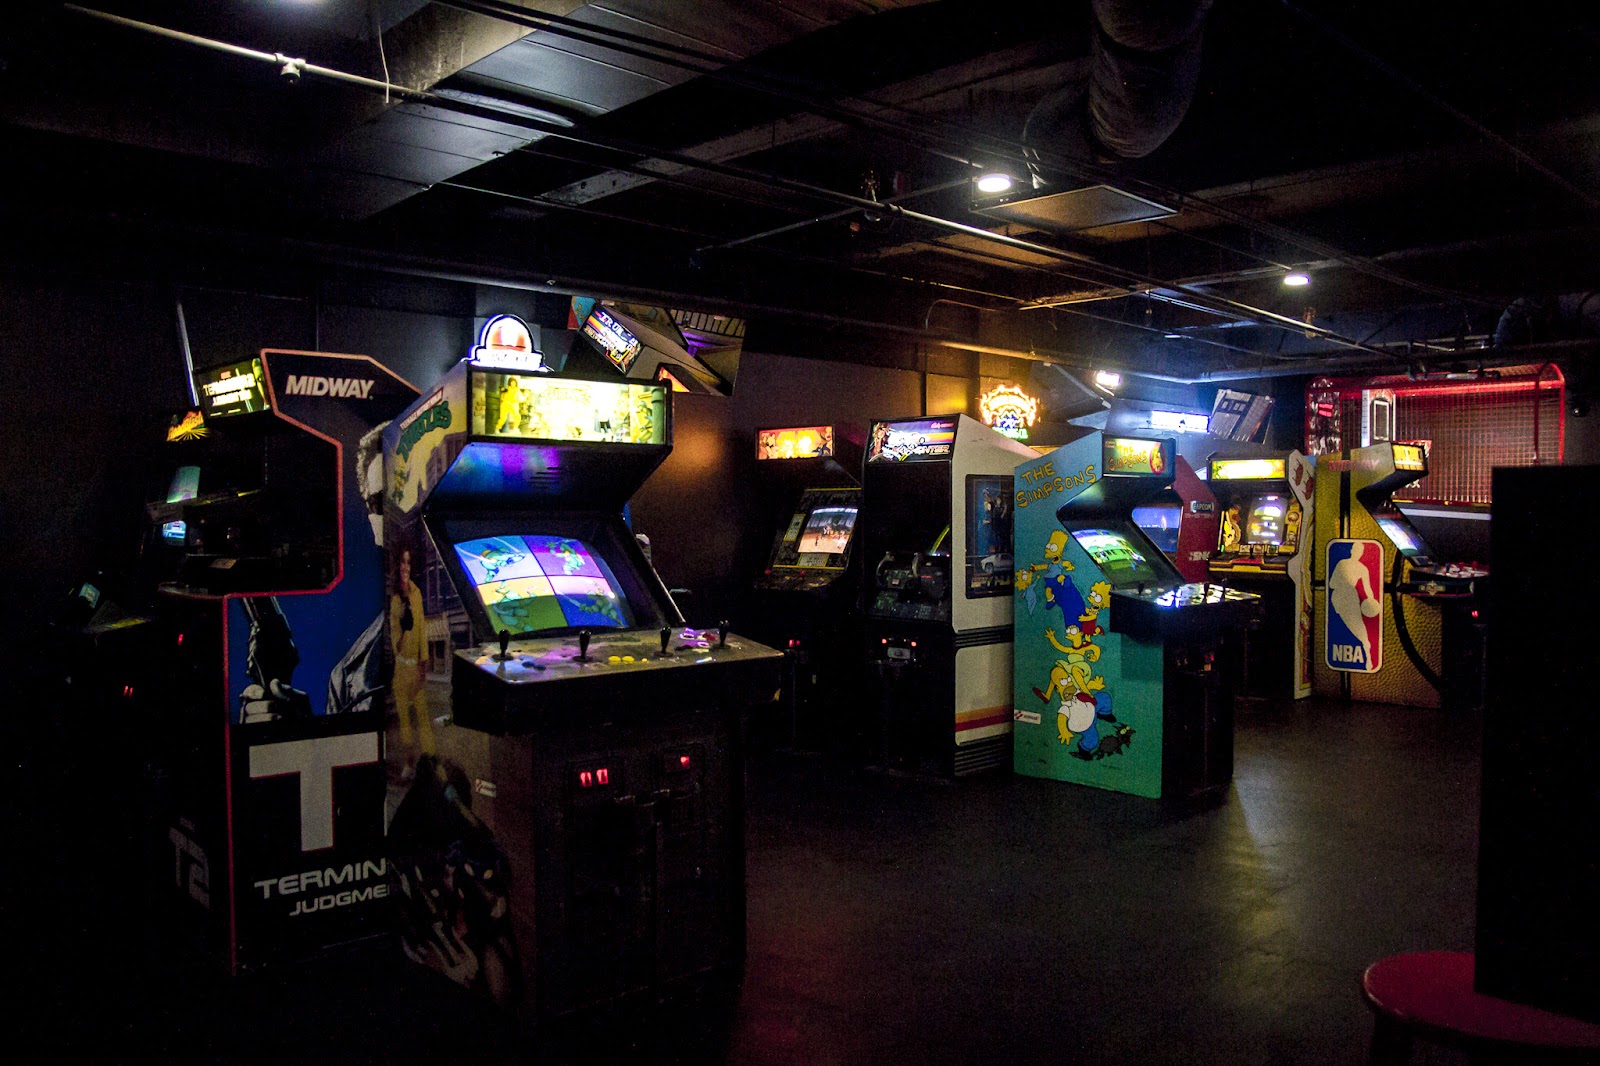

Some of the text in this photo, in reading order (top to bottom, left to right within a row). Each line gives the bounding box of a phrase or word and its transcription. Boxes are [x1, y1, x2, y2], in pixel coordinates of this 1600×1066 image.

[285, 374, 375, 400] MIDWAY
[396, 400, 452, 463] TURTLES
[1108, 450, 1148, 471] SIMPSONS
[1021, 462, 1056, 484] THE
[1015, 465, 1097, 508] SIMPSONS
[1191, 501, 1214, 512] CAPCOM
[1332, 644, 1365, 664] NBA
[253, 857, 387, 900] TERMIN
